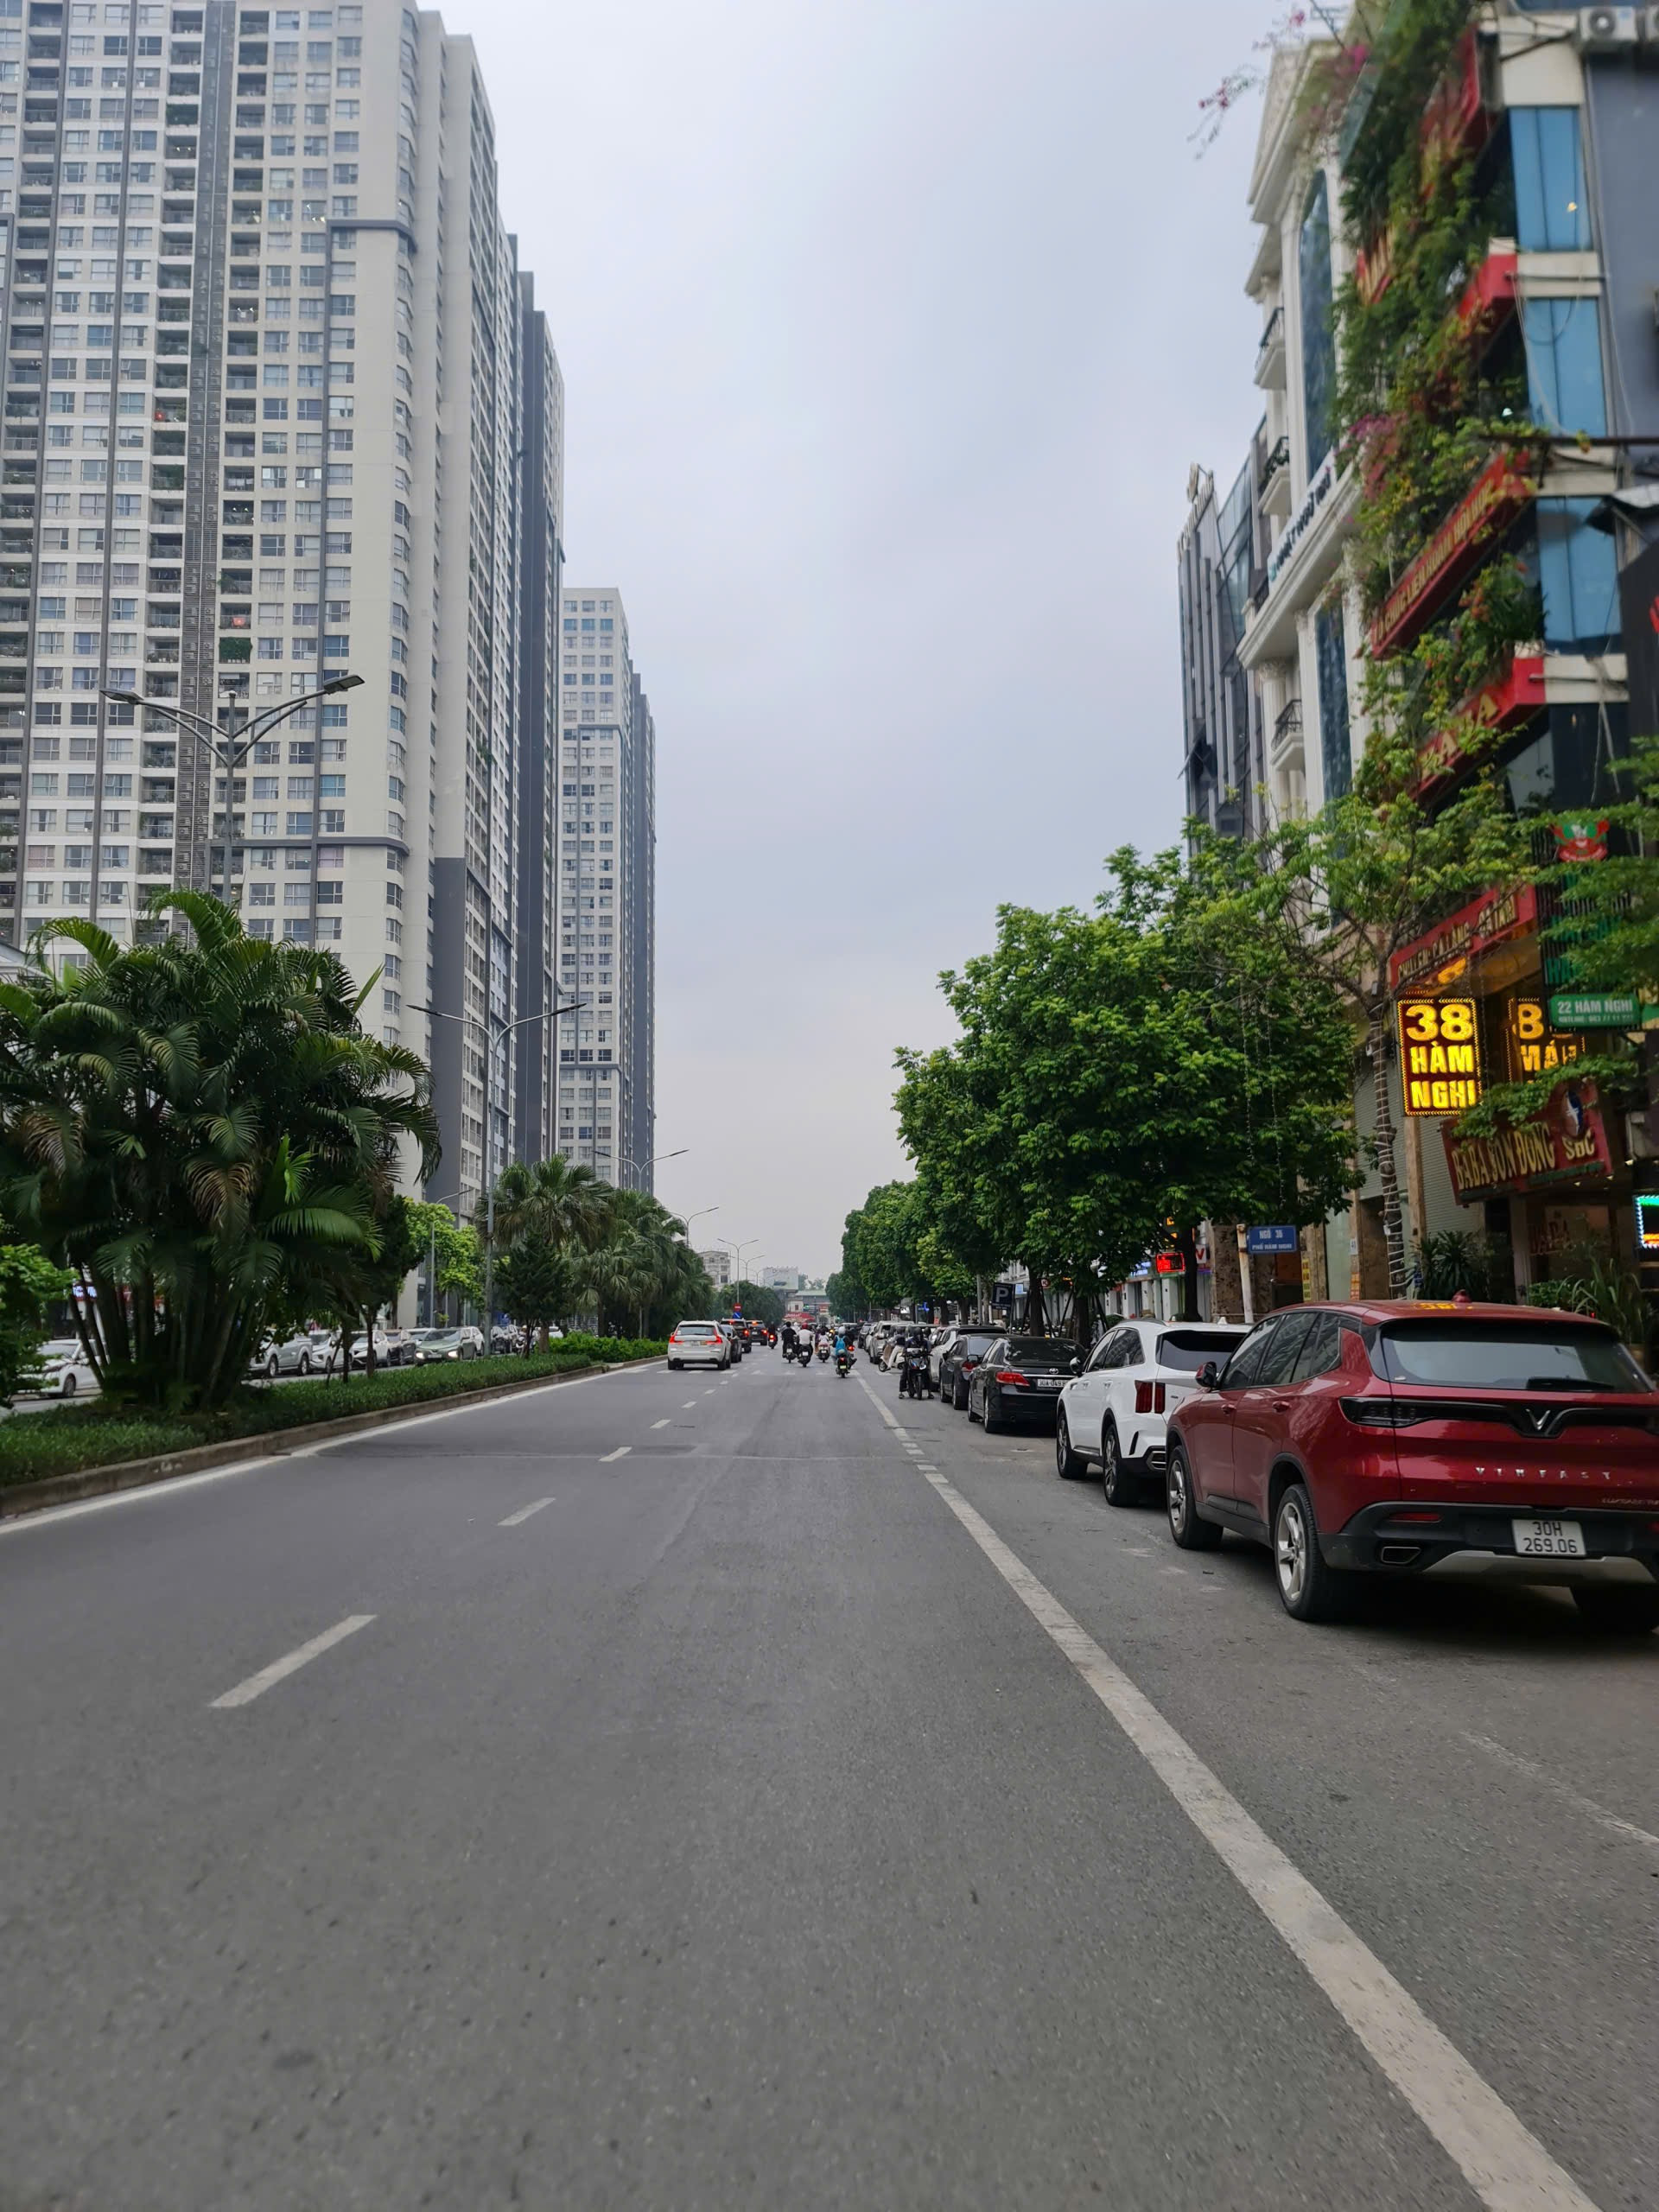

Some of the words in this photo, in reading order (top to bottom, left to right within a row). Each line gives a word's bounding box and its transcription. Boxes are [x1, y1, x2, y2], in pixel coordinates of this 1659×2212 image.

[1557, 1001, 1572, 1014] 22
[1605, 999, 1633, 1013] NGHI
[1406, 1003, 1473, 1041] 38
[1409, 1040, 1474, 1074] HÀM
[1409, 1079, 1477, 1109] NGHI
[995, 1287, 1009, 1302] P
[1476, 1466, 1611, 1480] VINFAST
[1532, 1521, 1563, 1537] 30H
[1522, 1537, 1578, 1554] 269.06
